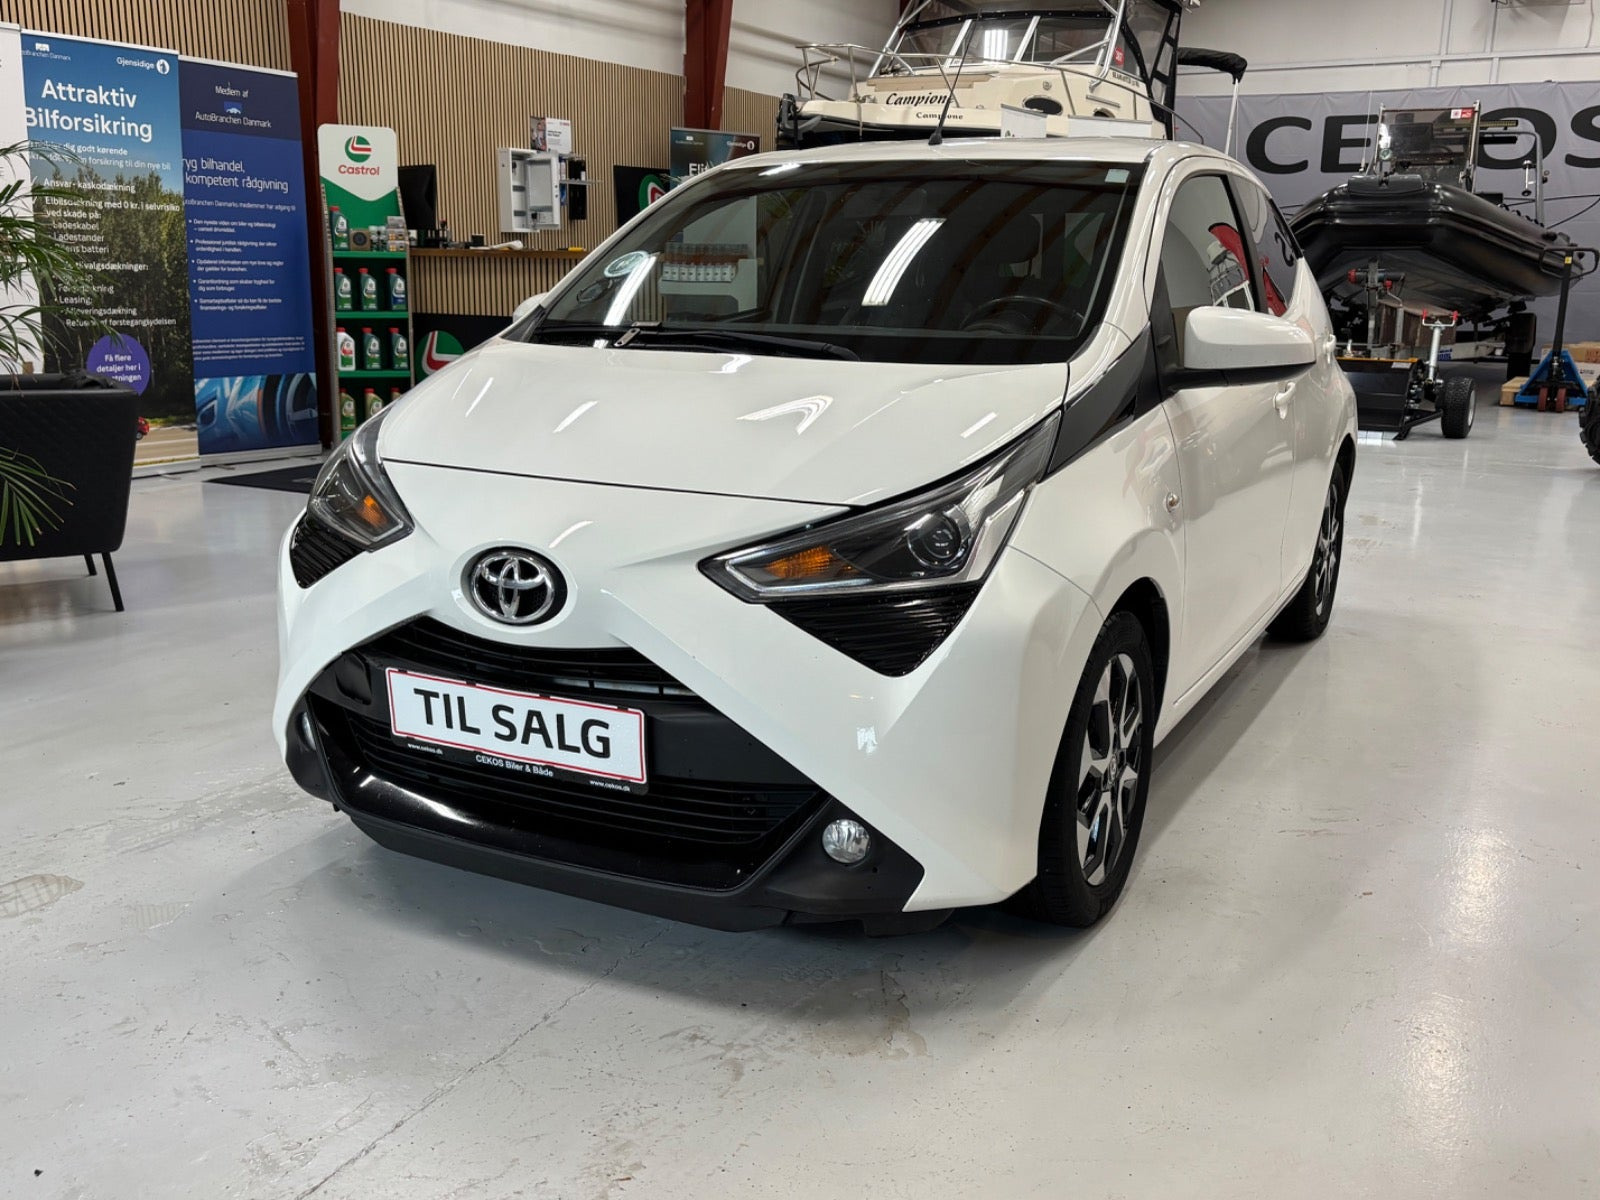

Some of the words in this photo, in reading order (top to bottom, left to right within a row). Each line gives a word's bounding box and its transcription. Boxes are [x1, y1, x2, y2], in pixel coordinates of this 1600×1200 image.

[116, 57, 155, 70] Gjensidige
[41, 79, 137, 108] Attraktiv
[215, 83, 241, 97] Medlem
[242, 90, 249, 98] af
[195, 111, 242, 125] AutoBranchen
[243, 117, 272, 128] Danmark
[916, 112, 964, 121] Campone
[25, 106, 153, 143] Bilforsikring
[1246, 106, 1600, 175] CEOS
[77, 145, 95, 154] godt
[97, 145, 128, 156] kørende
[88, 157, 124, 169] forsikring
[125, 159, 133, 168] til
[134, 160, 146, 168] din
[147, 162, 161, 171] nye
[162, 162, 171, 170] bil
[201, 157, 245, 174] bilhandel,
[338, 164, 380, 176] Castrol
[77, 179, 136, 194] kaskodækning
[185, 172, 239, 188] kompetent
[242, 176, 289, 194] rådgivning
[104, 200, 123, 209] med
[124, 201, 129, 209] 0
[145, 203, 180, 212] selvrisiko
[63, 210, 87, 219] skade
[81, 245, 109, 253] batteri
[104, 354, 114, 362] Få
[114, 354, 132, 362] flere
[96, 364, 124, 373] detaljer
[125, 363, 137, 371] her
[413, 687, 481, 736] TIL
[491, 704, 612, 760] SALG
[475, 754, 505, 768] CEKOS
[506, 761, 524, 772] Biler
[525, 764, 532, 773] &
[533, 765, 555, 777] Både
[589, 780, 631, 792] www.cekos.dk
